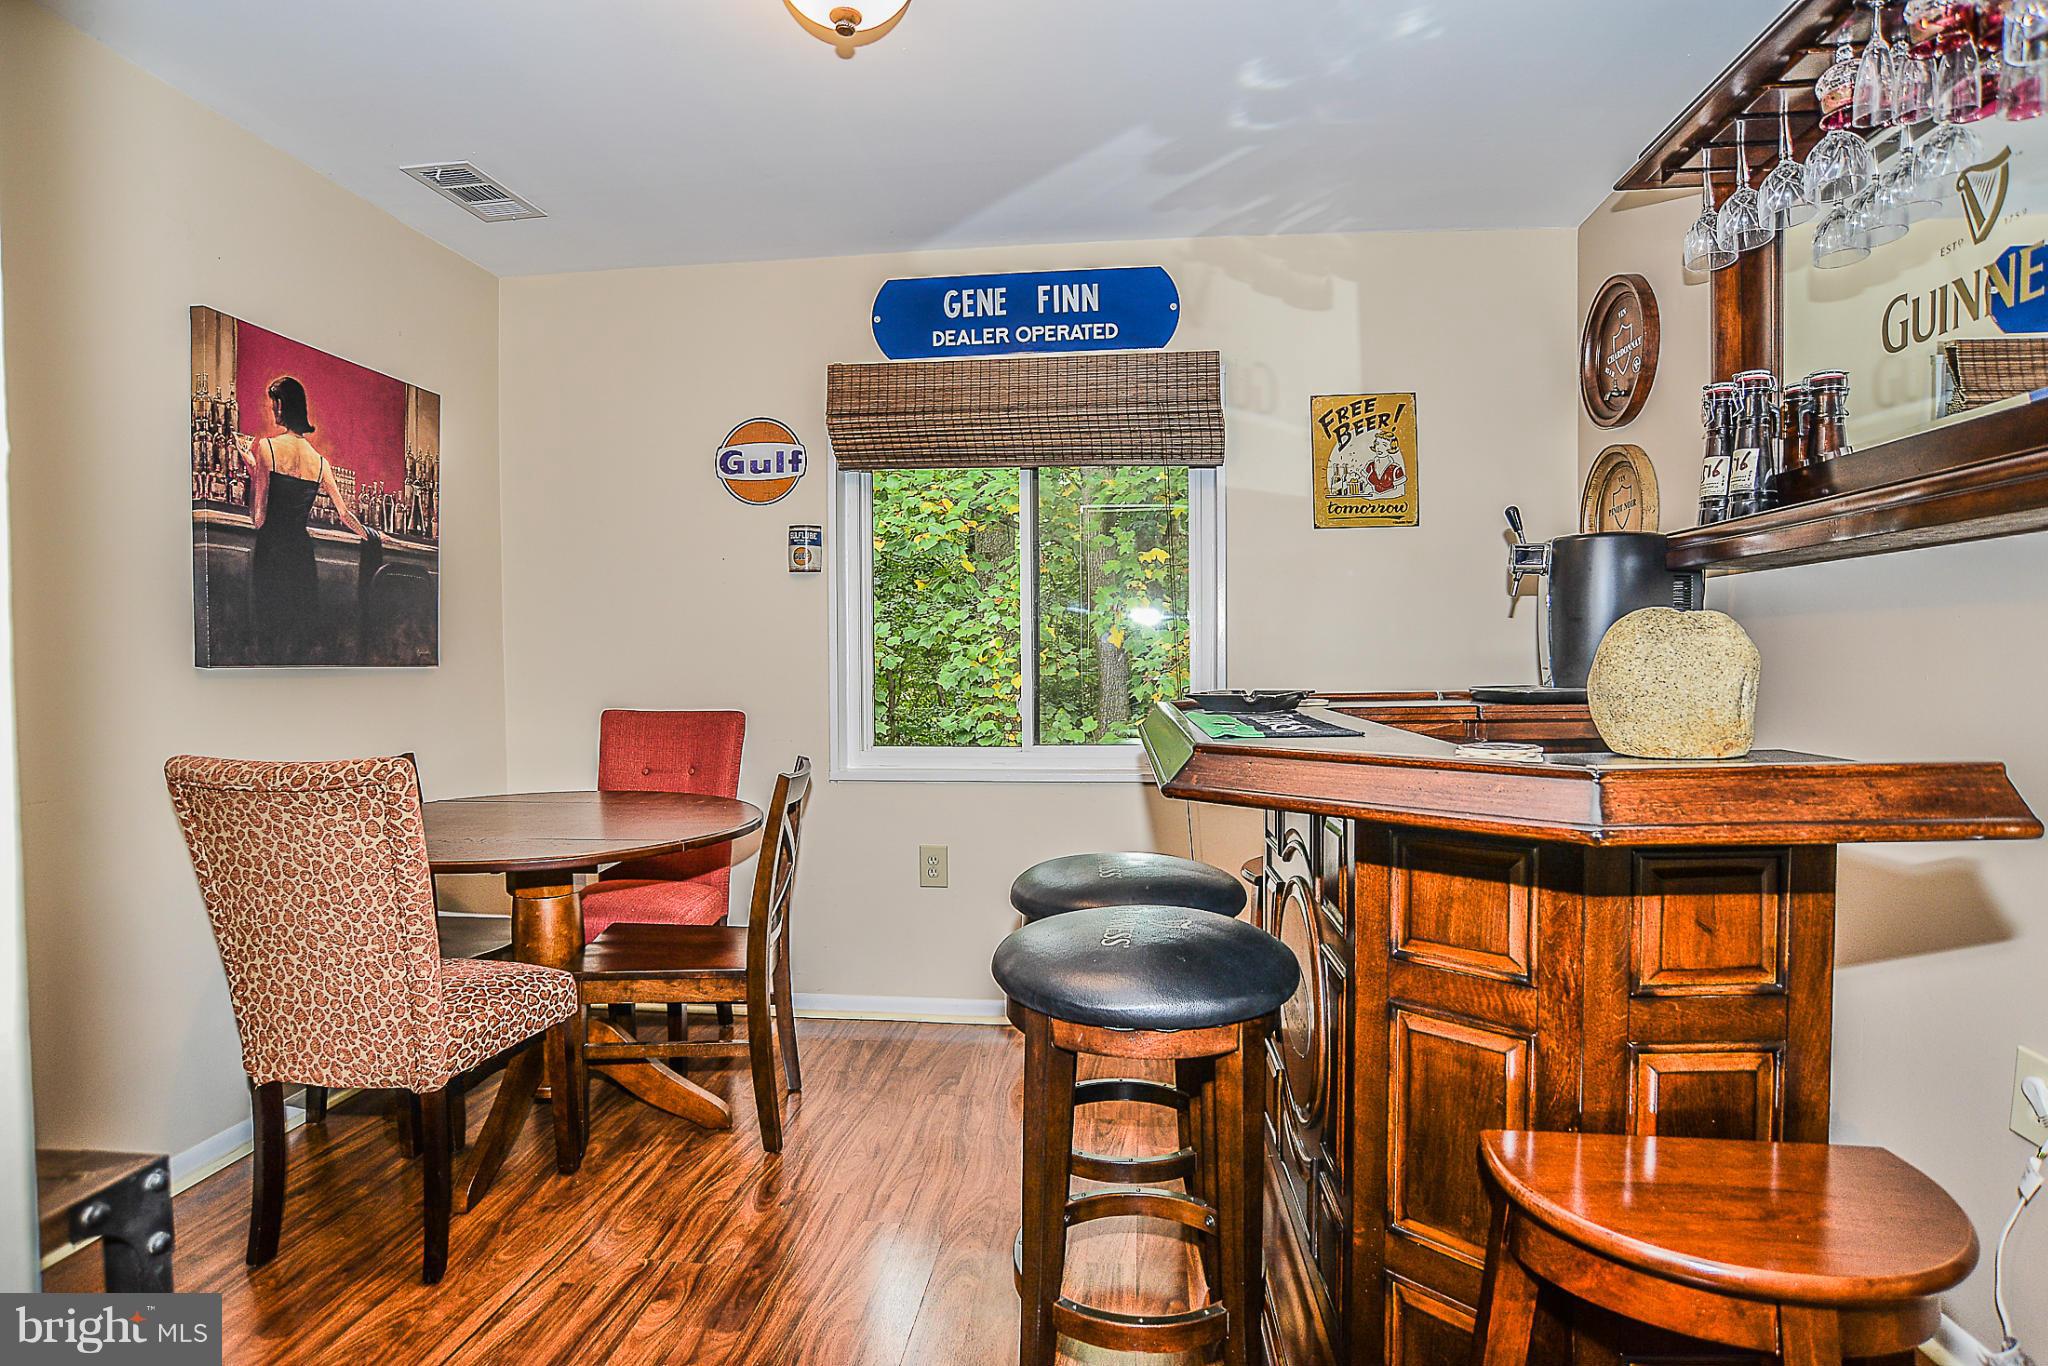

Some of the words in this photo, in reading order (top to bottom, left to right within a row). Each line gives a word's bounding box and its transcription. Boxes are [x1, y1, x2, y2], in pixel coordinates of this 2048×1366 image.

[943, 287, 1007, 319] GENE
[1037, 283, 1099, 314] FINN
[1881, 240, 2045, 354] GUINNE
[932, 327, 1009, 347] DEALER
[1015, 323, 1119, 344] OPERATED
[1318, 397, 1377, 440] FREE
[1333, 404, 1406, 453] BEER!
[719, 450, 803, 475] Gulf
[1327, 501, 1408, 515] tomorrow
